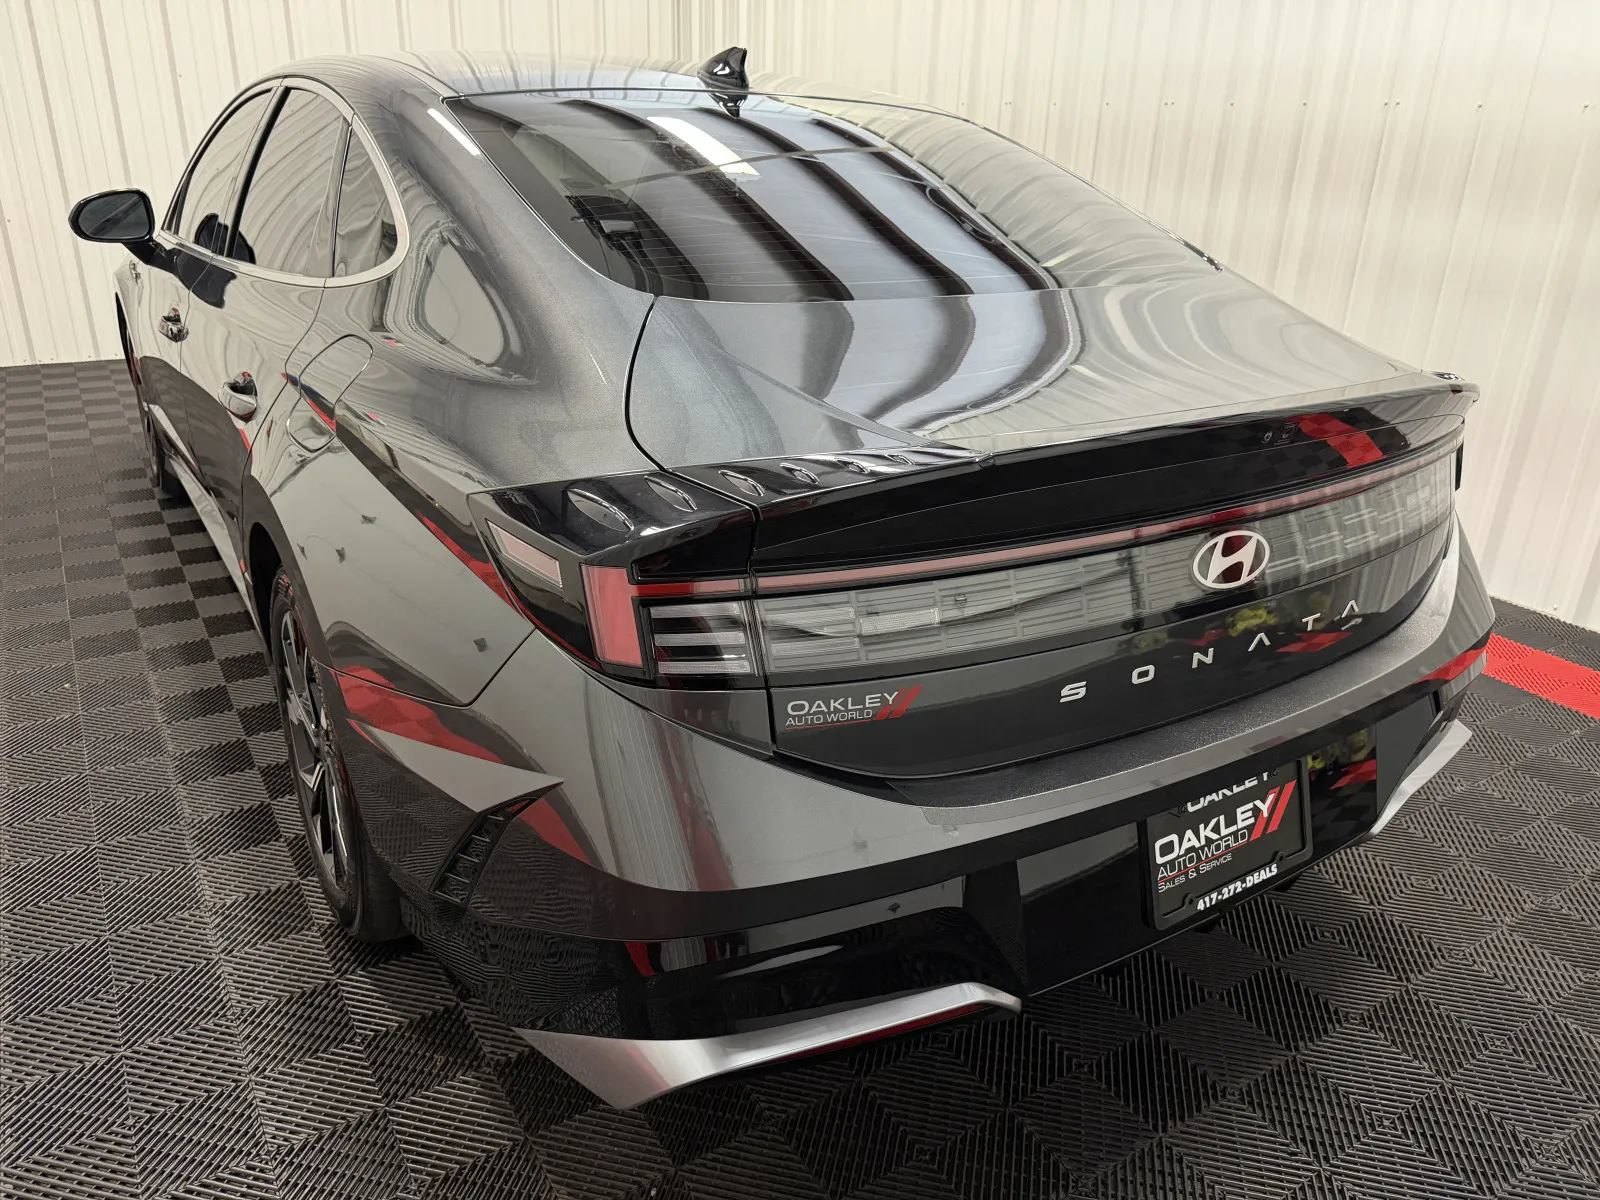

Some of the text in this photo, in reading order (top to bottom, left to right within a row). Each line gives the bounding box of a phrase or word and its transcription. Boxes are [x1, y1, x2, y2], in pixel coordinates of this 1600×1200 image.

[785, 709, 873, 726] AUTO WORLD
[786, 691, 899, 715] OAKLEY
[1154, 793, 1275, 865] OAKLEY
[1157, 829, 1248, 880] AUTO WORLD
[1188, 868, 1197, 879] &
[1196, 863, 1278, 911] 417-272-DEALS
